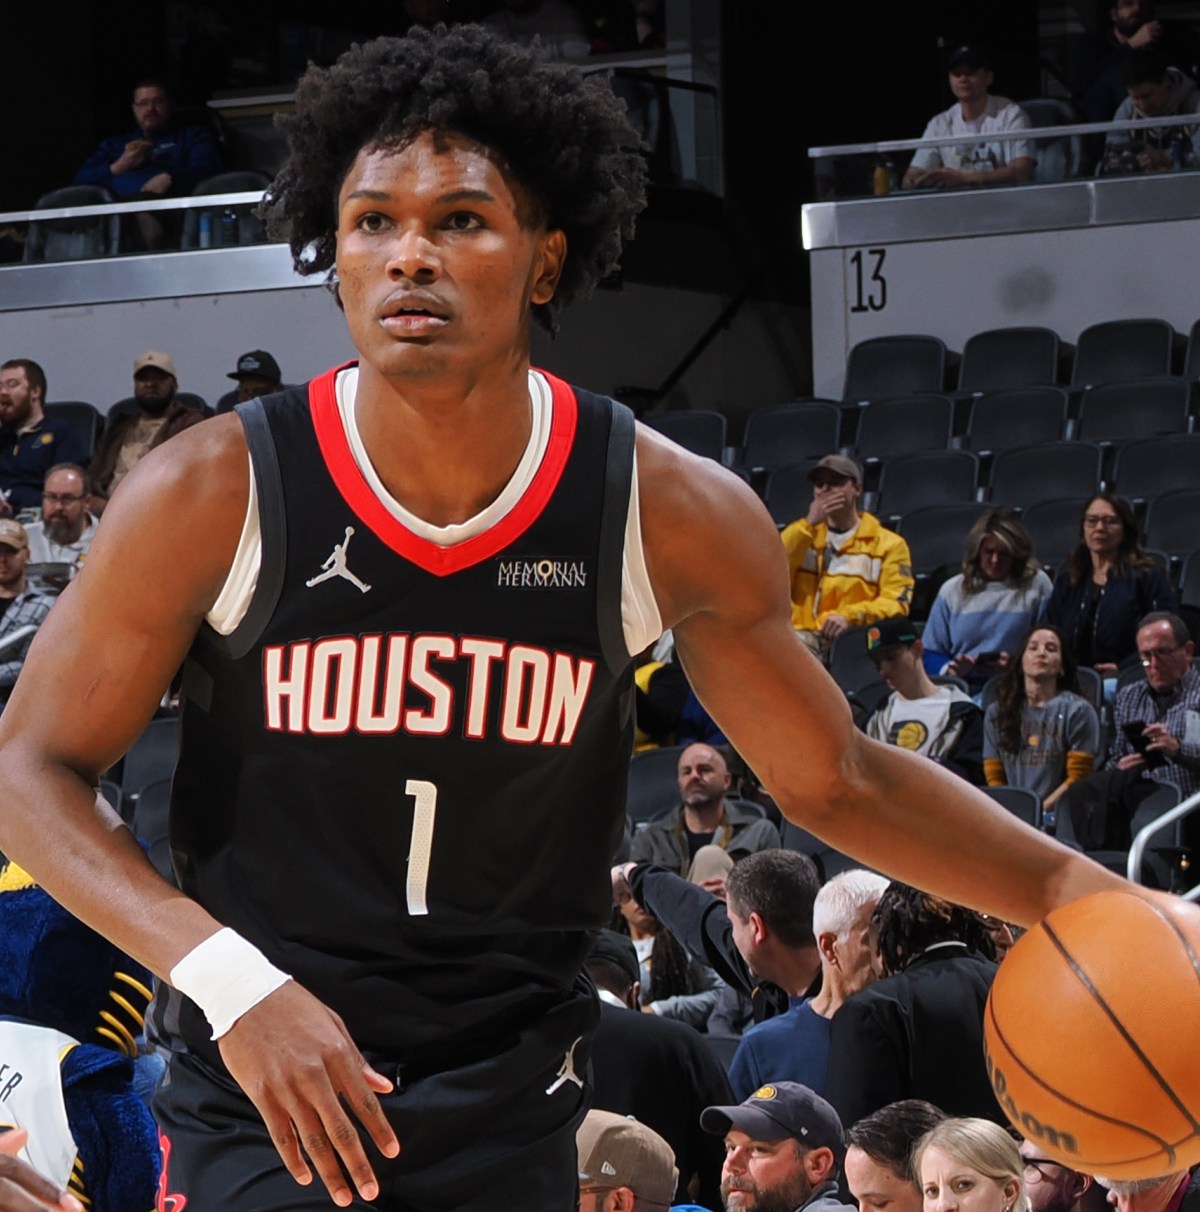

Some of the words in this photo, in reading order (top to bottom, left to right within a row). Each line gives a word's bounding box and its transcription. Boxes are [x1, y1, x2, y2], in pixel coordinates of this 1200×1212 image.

[850, 248, 887, 313] 13
[497, 572, 587, 587] HERMANN
[498, 560, 587, 577] MEMORIAL
[263, 632, 597, 746] HOUSTON
[404, 779, 438, 915] 1
